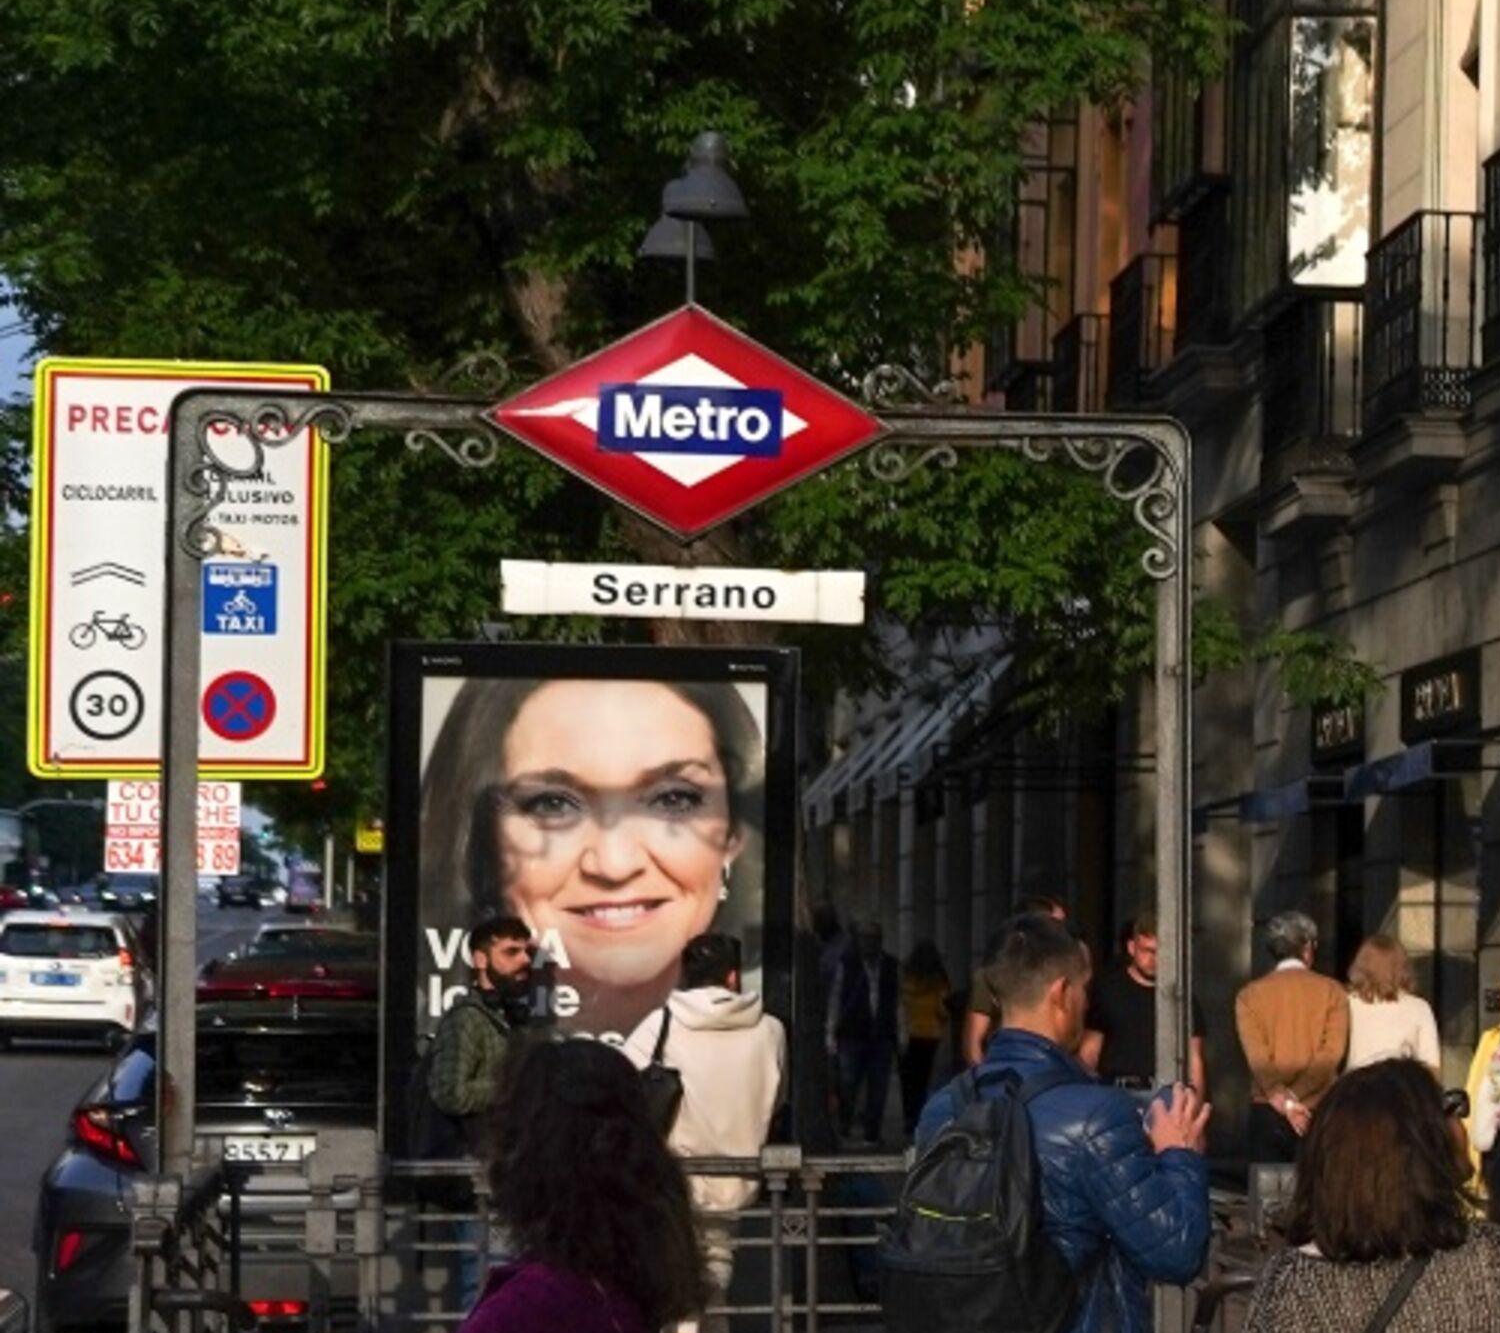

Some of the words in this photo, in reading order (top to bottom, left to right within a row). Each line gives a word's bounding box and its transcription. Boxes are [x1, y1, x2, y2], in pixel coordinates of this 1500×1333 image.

[614, 393, 772, 441] Metro
[62, 485, 157, 502] CICLOCARRIL
[592, 573, 777, 609] Serrano
[216, 615, 264, 632] TAXI
[86, 694, 128, 716] 30
[119, 781, 229, 803] CORO
[111, 803, 141, 821] TU
[107, 842, 145, 868] 634
[213, 844, 237, 870] 89
